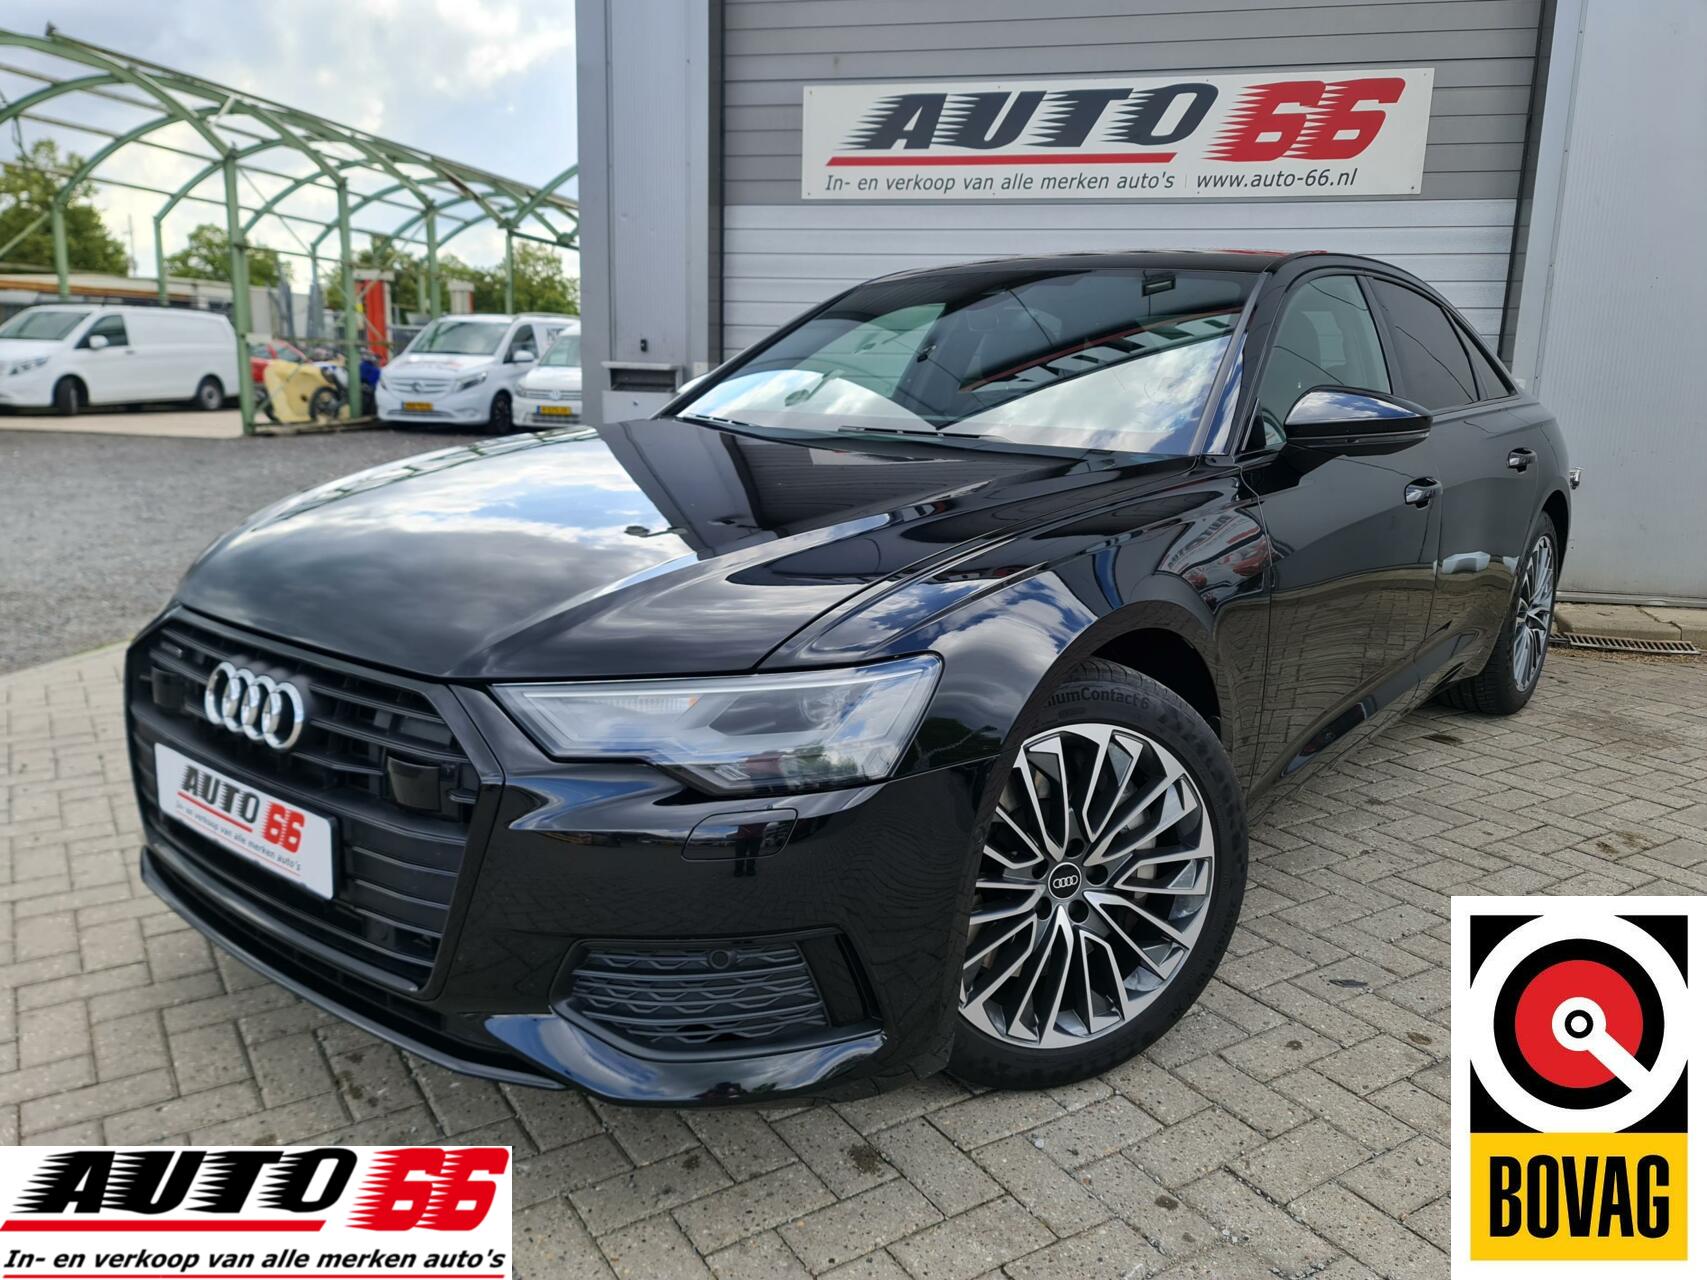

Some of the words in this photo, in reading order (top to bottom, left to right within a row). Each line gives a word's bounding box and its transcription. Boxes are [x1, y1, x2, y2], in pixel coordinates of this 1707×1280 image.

[834, 82, 1219, 150] AUTO
[1200, 77, 1406, 163] 66
[825, 174, 851, 191] In-
[857, 176, 878, 191] en
[886, 175, 956, 194] verkoop
[963, 177, 994, 191] van
[1001, 173, 1034, 190] alle
[1040, 172, 1109, 190] merken
[1116, 171, 1176, 189] auto's
[1197, 168, 1358, 189] www.auto-66.nl
[180, 765, 260, 824] AUTO
[262, 800, 305, 854] 66
